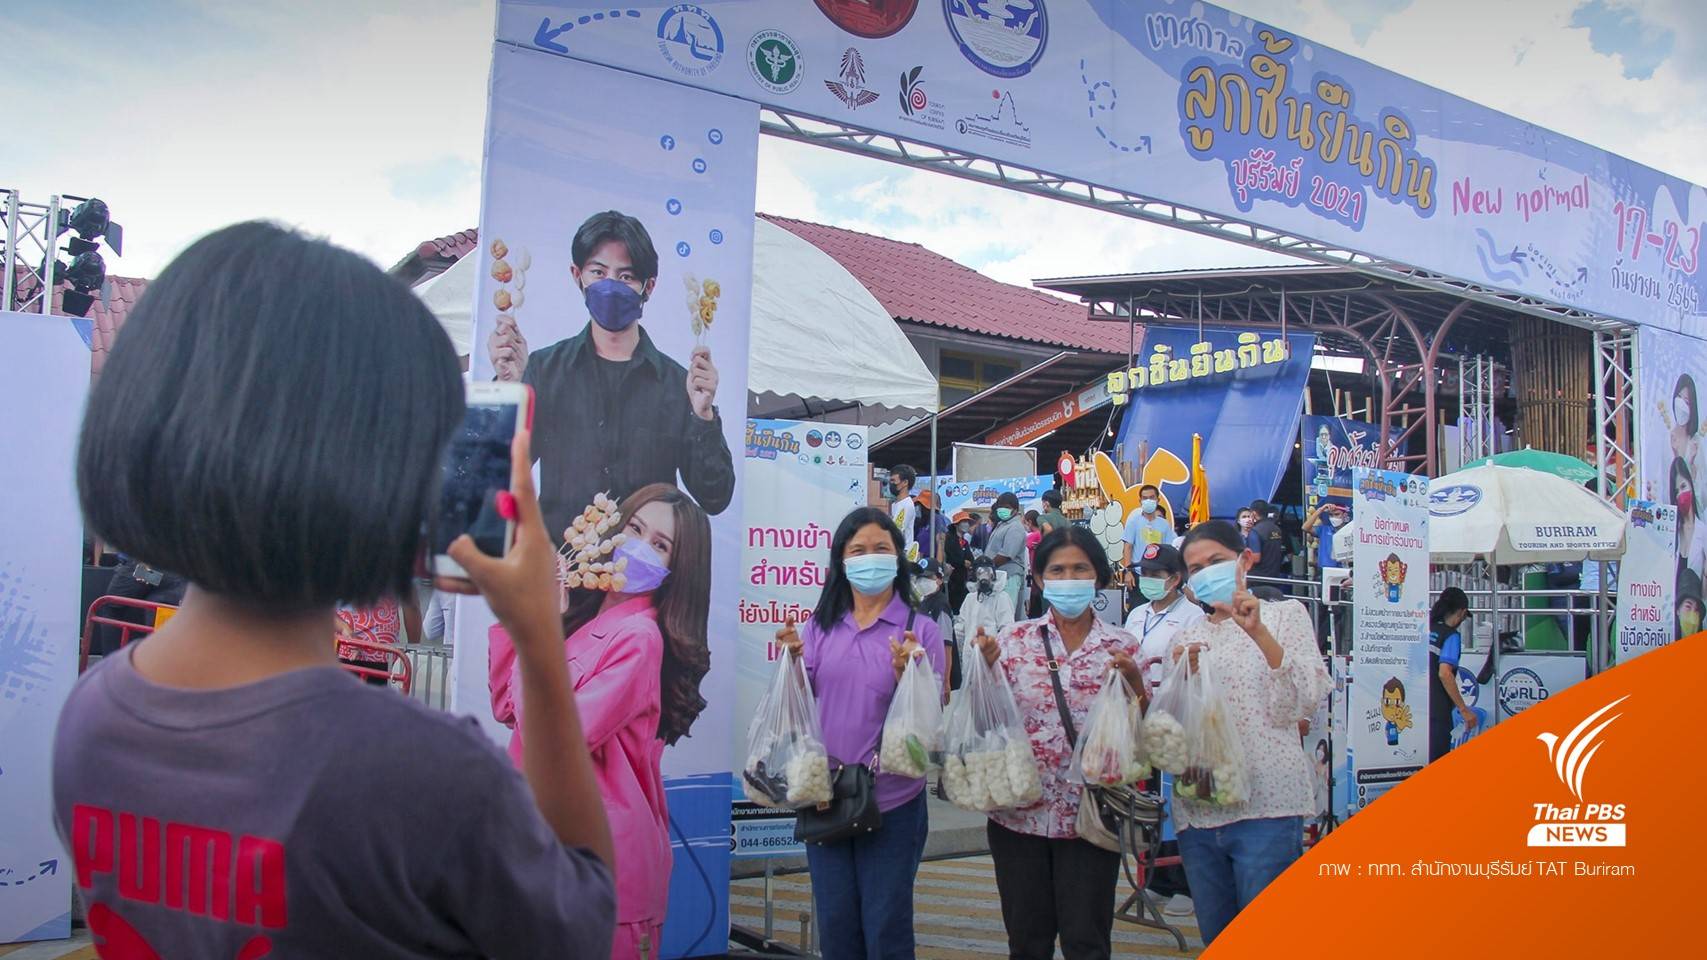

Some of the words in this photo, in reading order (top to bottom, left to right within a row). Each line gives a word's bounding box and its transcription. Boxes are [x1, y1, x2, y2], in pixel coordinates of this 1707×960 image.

[1145, 14, 1244, 59] เทศกาล
[1309, 175, 1364, 223] 2021
[1453, 177, 1503, 217] New
[1516, 175, 1590, 223] normal
[1613, 200, 1700, 274] 17-23
[1667, 281, 1699, 312] 2564
[748, 522, 832, 549] ทางเข้า
[1535, 525, 1598, 538] BURIRAM
[1566, 541, 1591, 549] SPORTS
[1592, 541, 1617, 549] OFFICE
[1630, 580, 1662, 598] ทางเข้า
[1630, 604, 1662, 622] สำหรับ
[73, 804, 288, 929] PUMA
